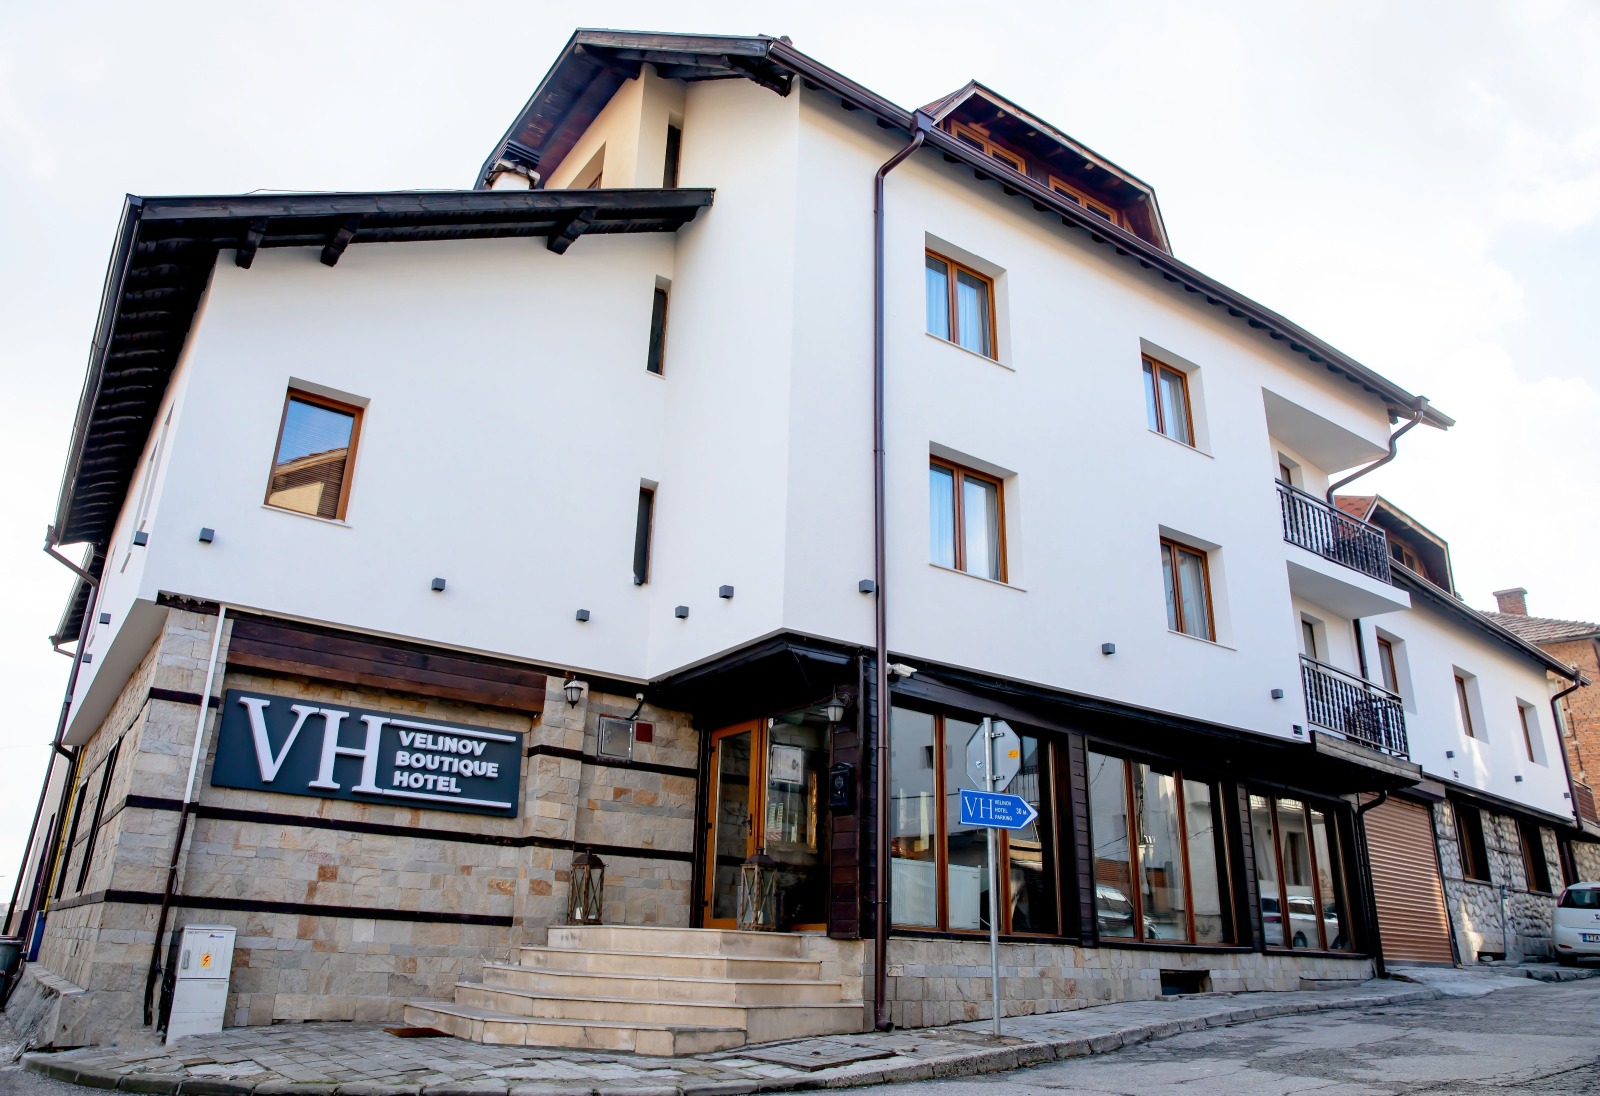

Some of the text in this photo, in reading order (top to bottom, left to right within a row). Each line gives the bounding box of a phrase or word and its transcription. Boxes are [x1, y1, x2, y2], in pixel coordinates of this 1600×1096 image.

[239, 696, 391, 794] VH
[398, 730, 487, 757] VELINOV
[394, 751, 500, 779] BOUTIQUE
[392, 771, 462, 794] HOTEL
[963, 796, 994, 820] VH
